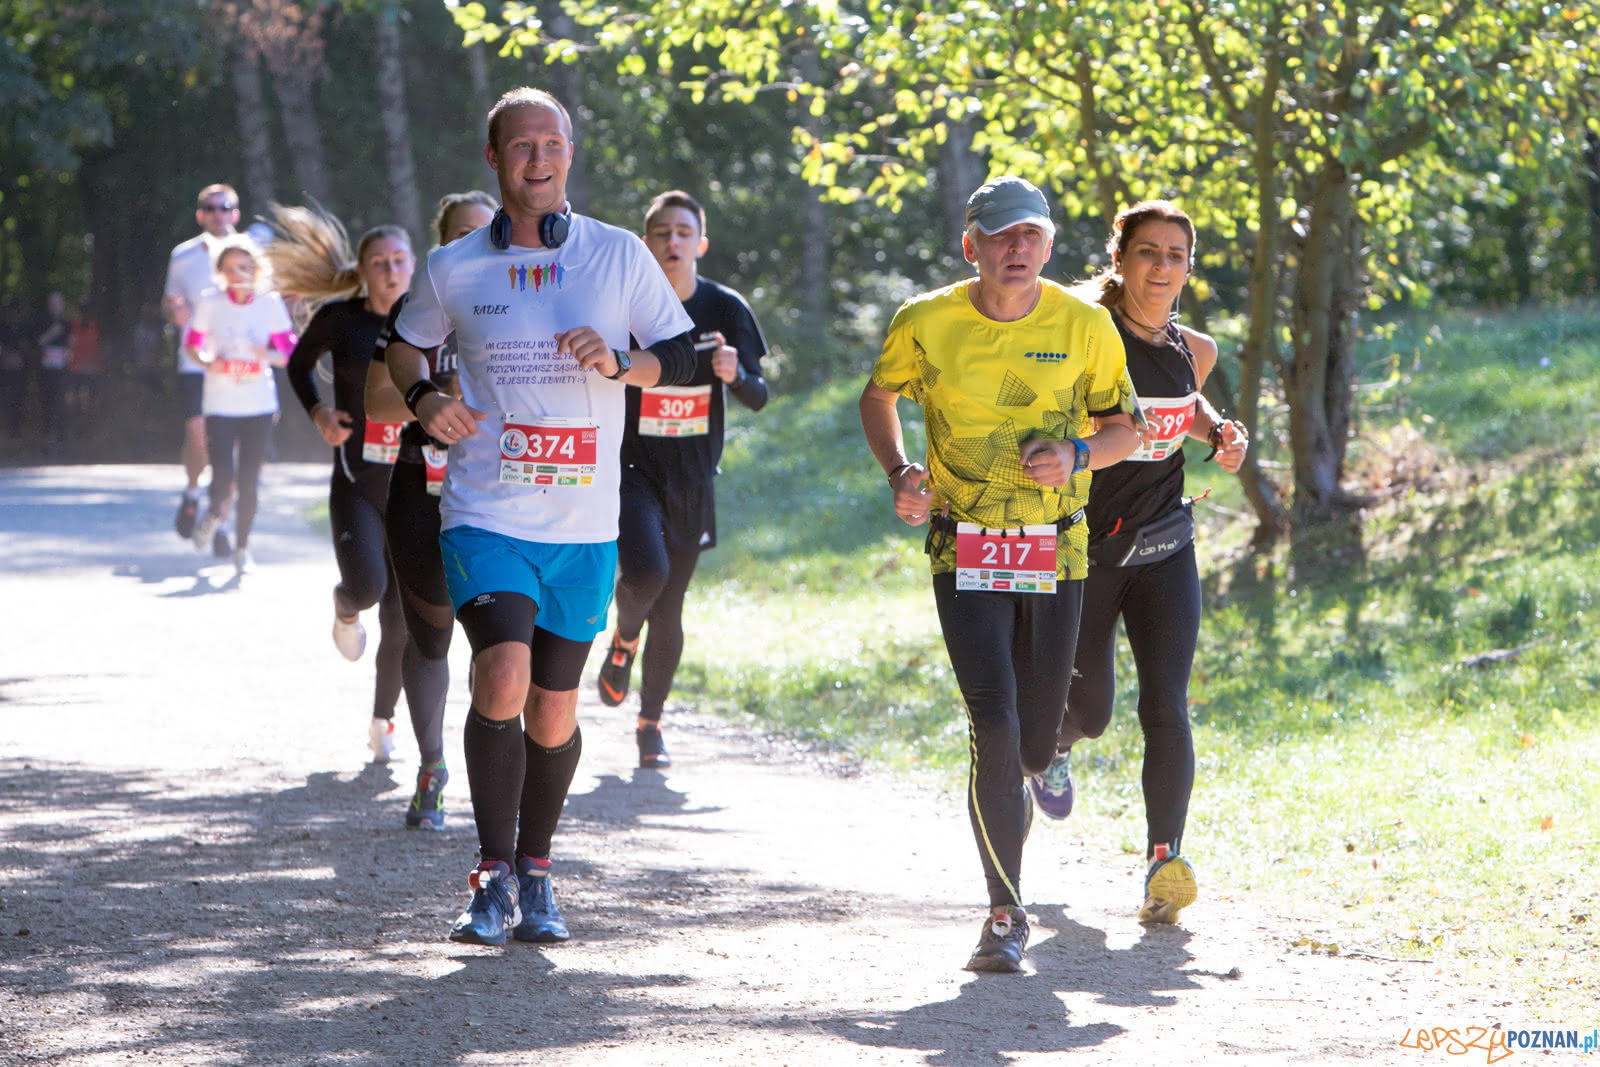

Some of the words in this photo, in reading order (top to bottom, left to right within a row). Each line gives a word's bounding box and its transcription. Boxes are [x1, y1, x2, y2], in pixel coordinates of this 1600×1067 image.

[473, 304, 508, 315] RADEK
[486, 342, 495, 351] IM
[533, 352, 550, 361] TYM
[551, 351, 576, 361] SZYB
[486, 364, 553, 374] PRZYZWYCZAISZ
[658, 398, 696, 417] 309
[527, 434, 575, 459] 374
[981, 541, 1032, 566] 217
